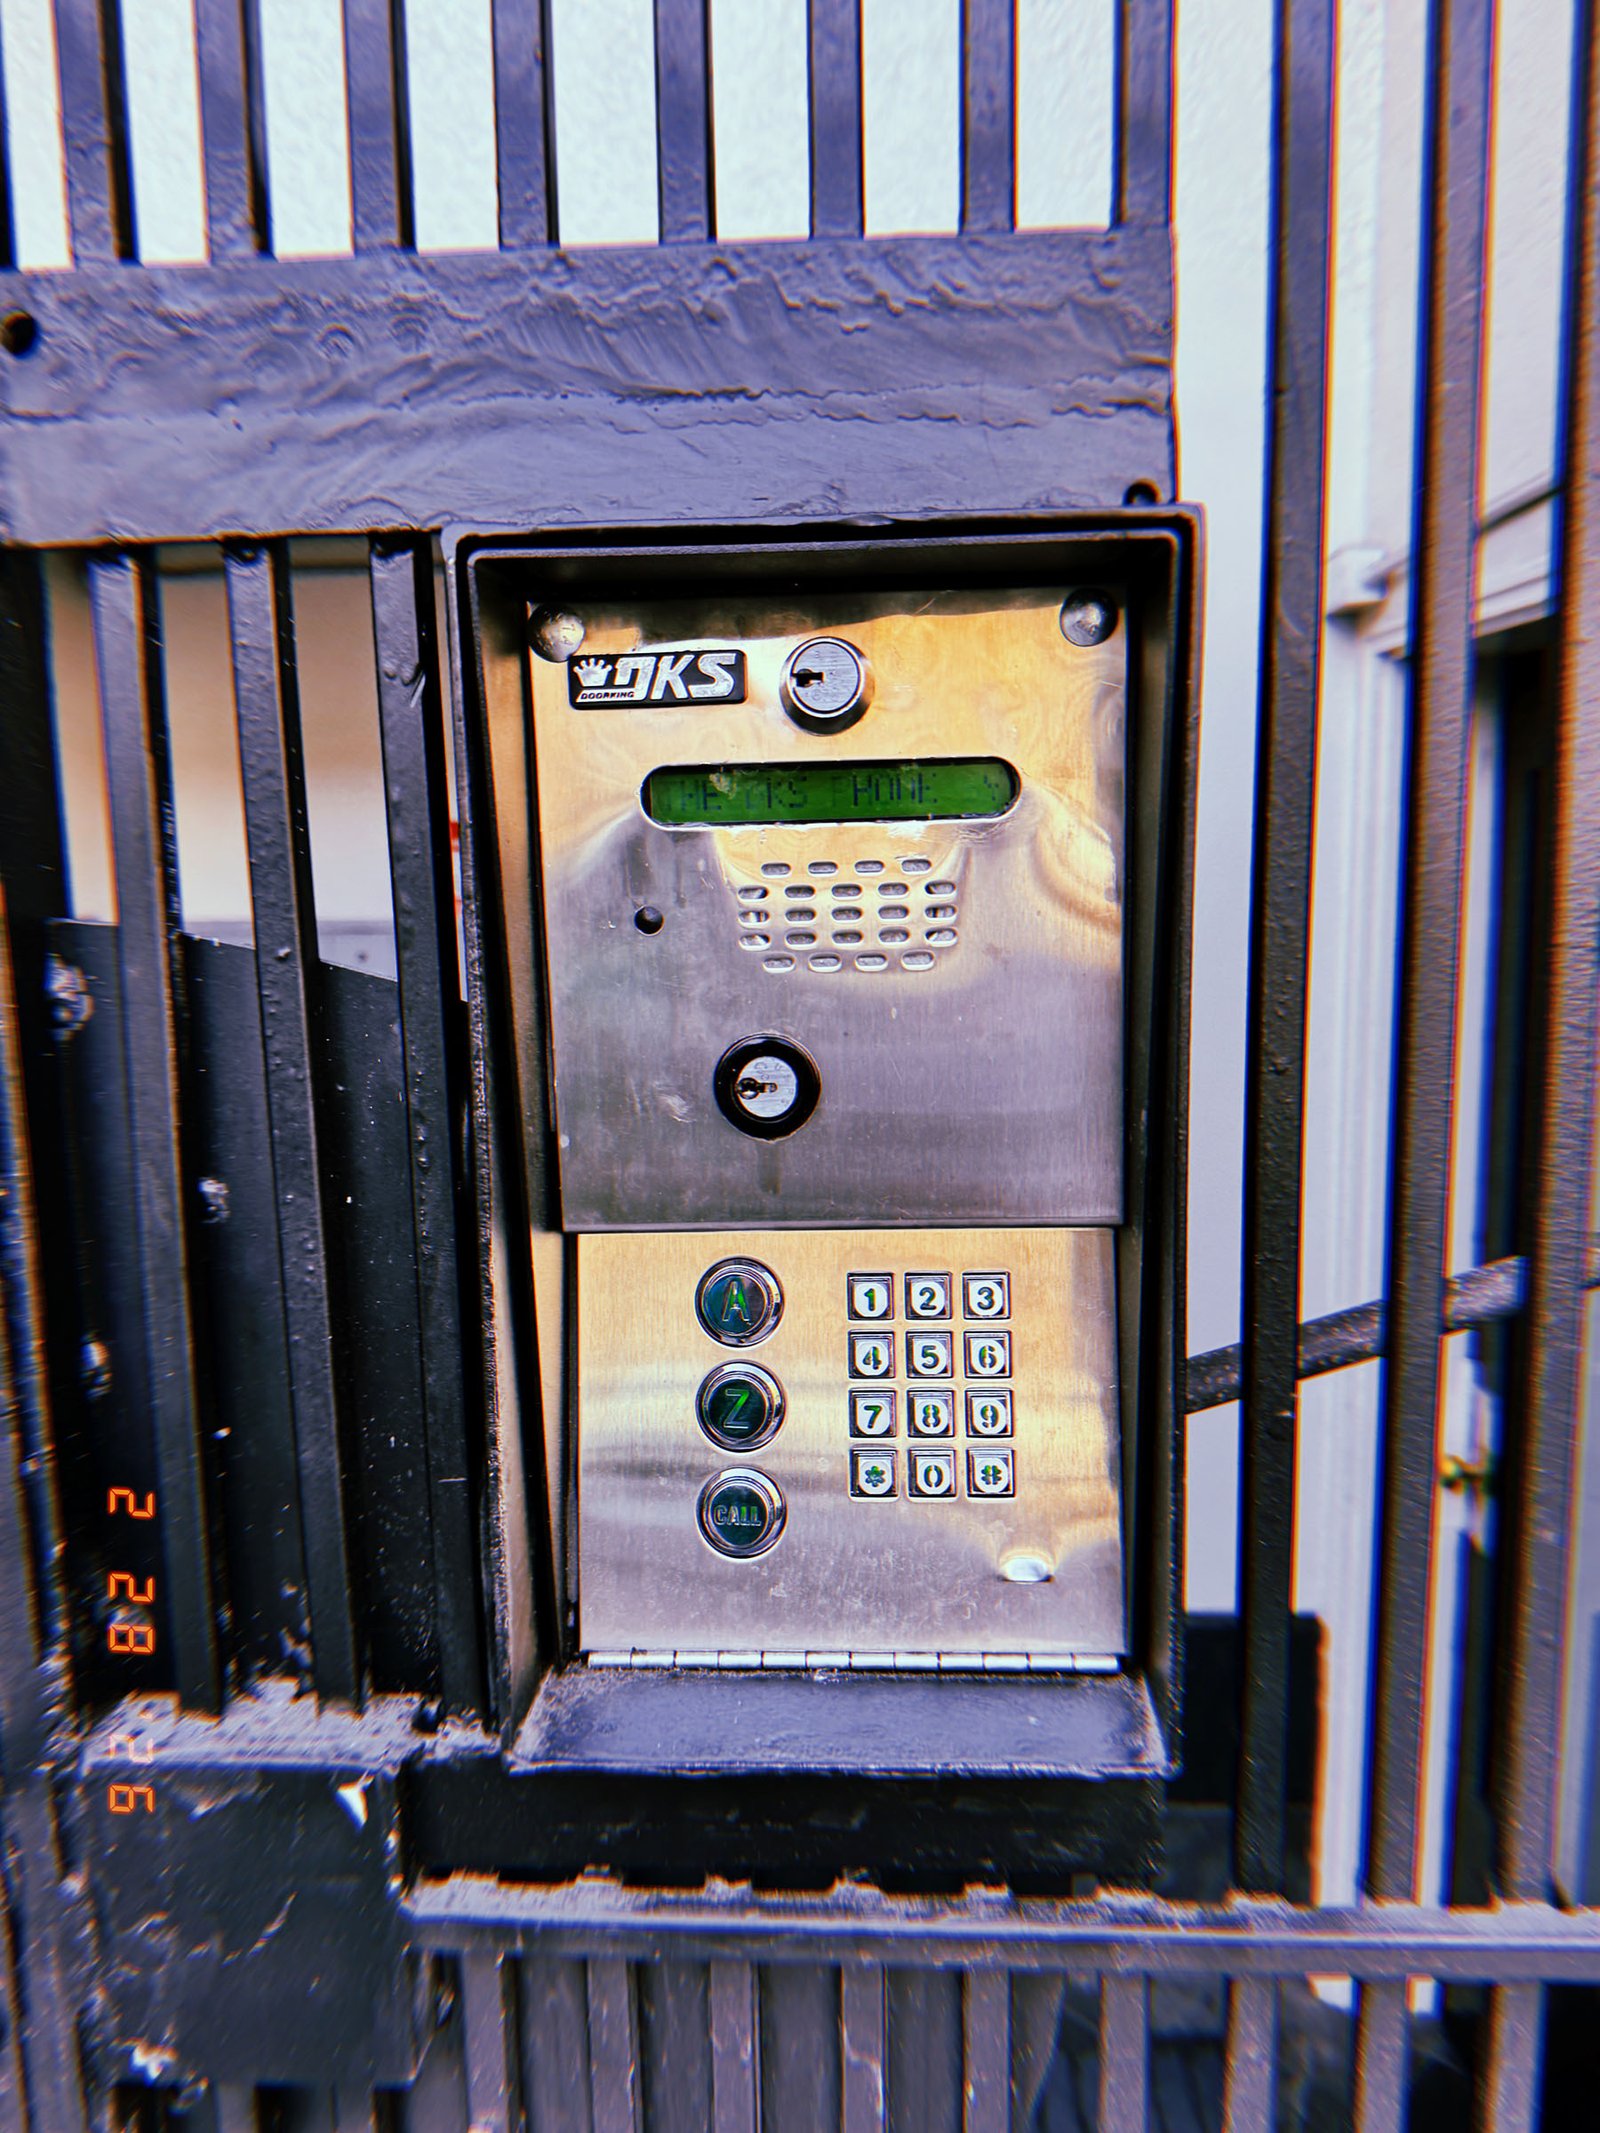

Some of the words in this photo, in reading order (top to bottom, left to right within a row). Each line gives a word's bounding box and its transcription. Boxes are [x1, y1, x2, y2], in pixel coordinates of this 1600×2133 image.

[612, 653, 737, 701] DKS
[580, 690, 635, 701] DOORKING
[721, 1279, 751, 1323] A
[863, 1287, 876, 1312] 1
[918, 1286, 938, 1311] 2
[976, 1286, 996, 1311] 3
[861, 1345, 883, 1370] 4
[920, 1344, 940, 1370] 5
[978, 1345, 998, 1369] 6
[722, 1388, 750, 1430] Z
[863, 1404, 883, 1429] 7
[921, 1403, 941, 1429] 8
[980, 1404, 1000, 1429] 9
[923, 1464, 944, 1489] 0
[712, 1504, 763, 1527] CALL
